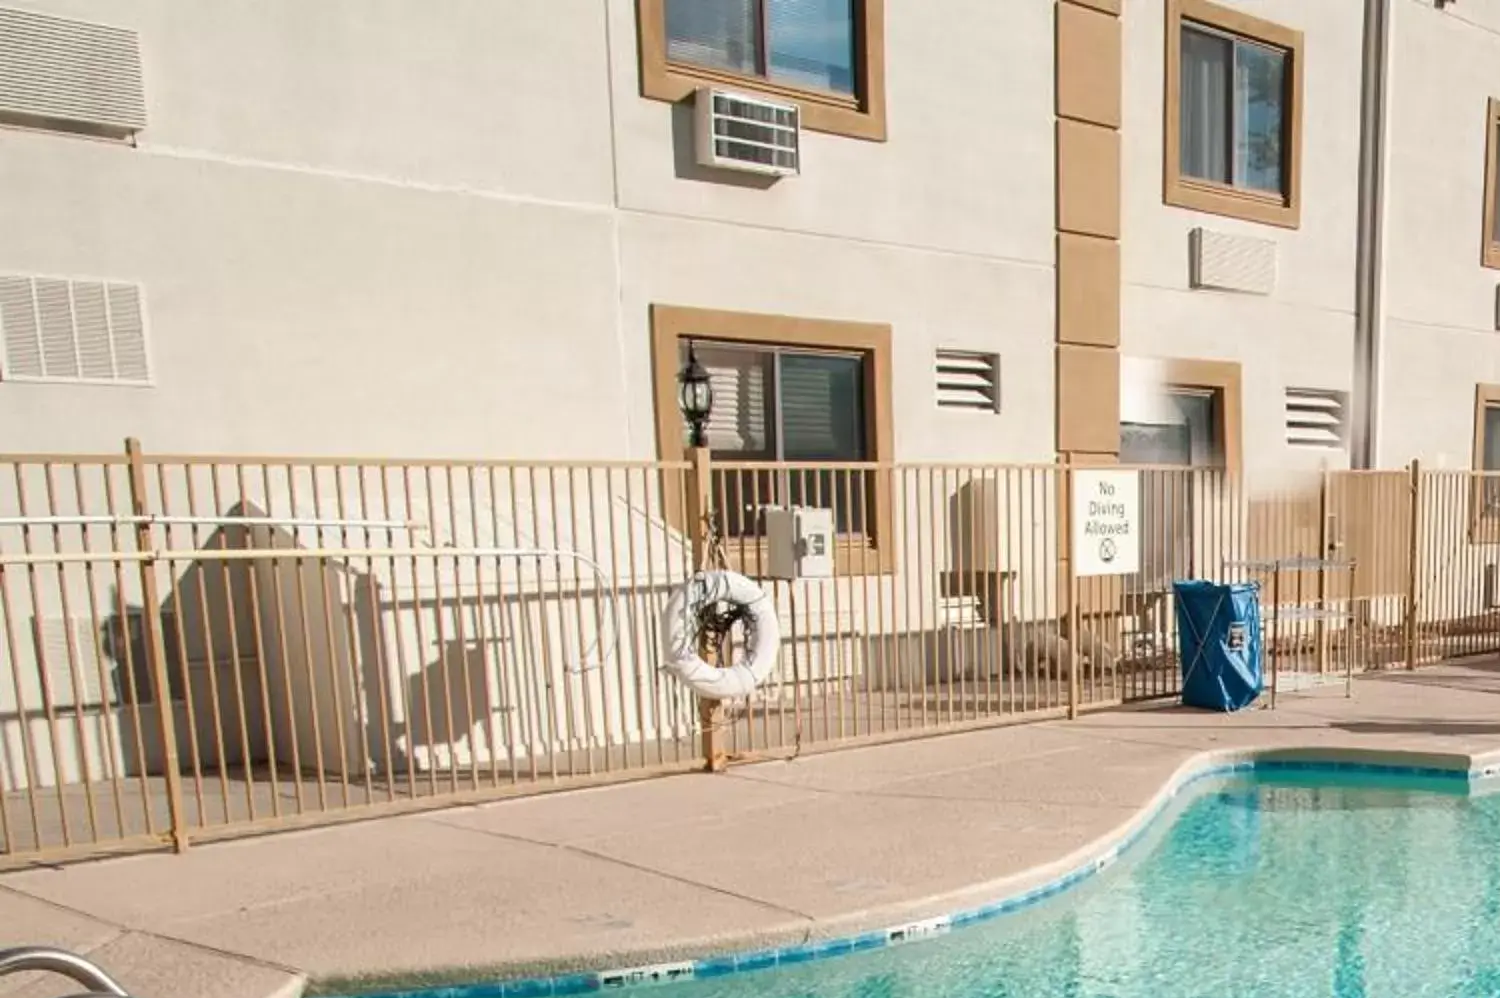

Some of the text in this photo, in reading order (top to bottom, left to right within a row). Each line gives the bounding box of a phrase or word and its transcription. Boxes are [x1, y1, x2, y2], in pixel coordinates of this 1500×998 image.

[1099, 481, 1115, 496] No
[1089, 501, 1125, 518] Diving
[1084, 522, 1130, 536] Allowed
